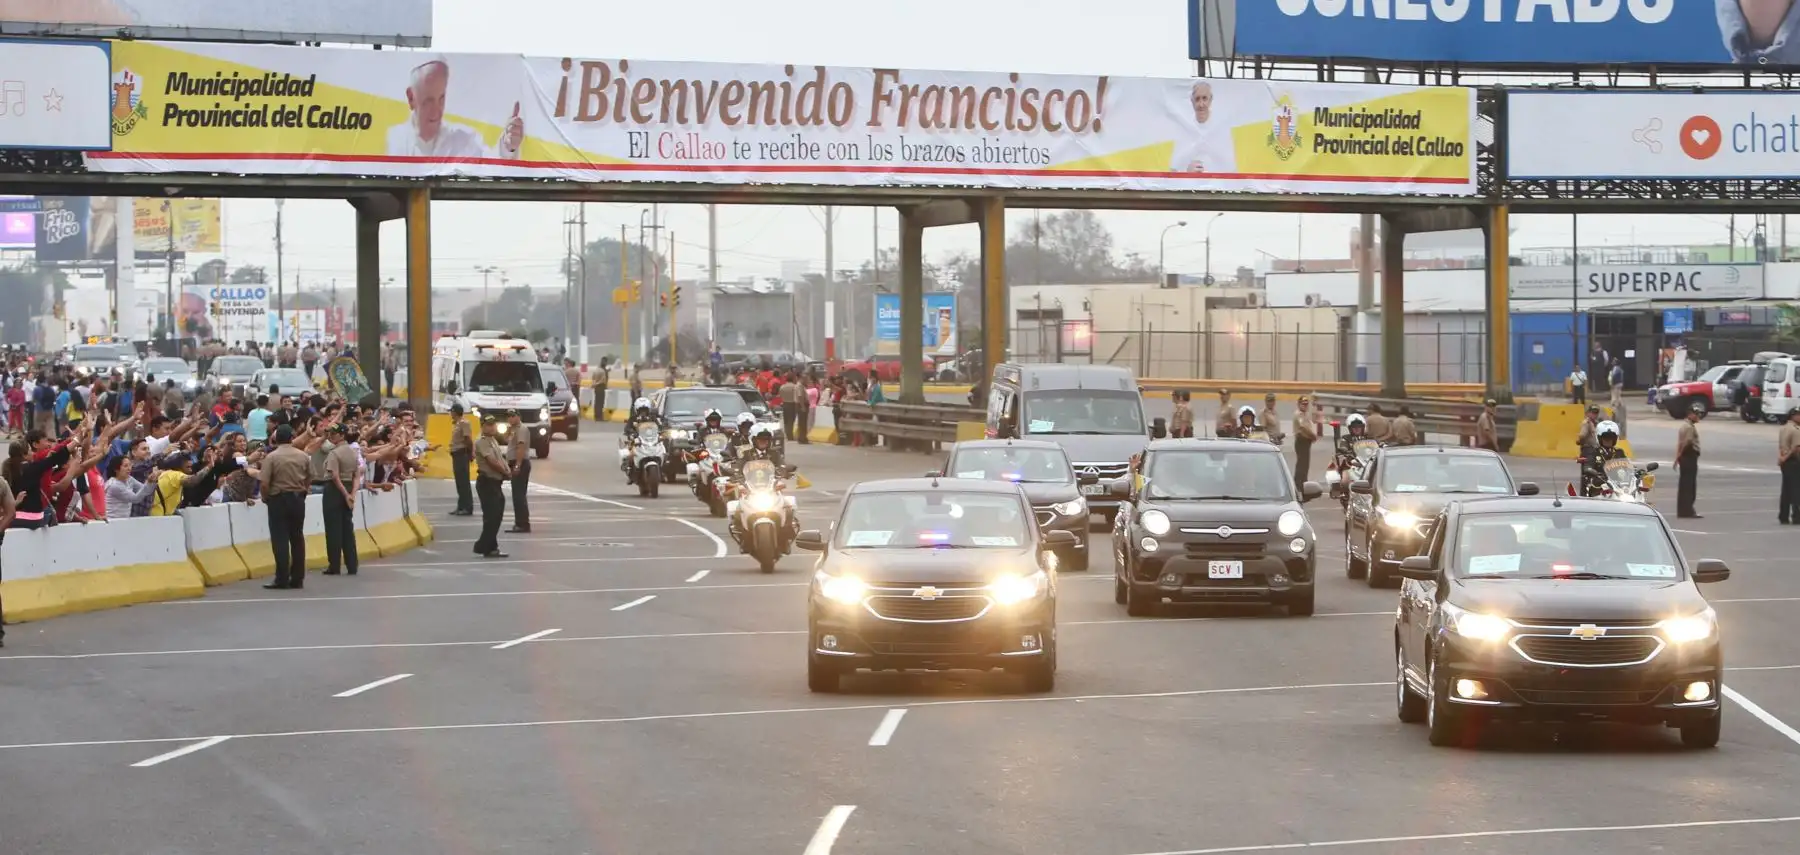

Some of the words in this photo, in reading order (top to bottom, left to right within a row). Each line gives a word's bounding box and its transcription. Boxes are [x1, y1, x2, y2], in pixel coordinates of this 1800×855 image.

[164, 71, 316, 101] Municipalidad
[554, 57, 854, 127] ¡Bienvenido
[866, 68, 1109, 133] Francisco!
[162, 102, 268, 128] Provincial
[271, 104, 303, 128] del
[306, 105, 372, 130] Callao
[1314, 107, 1422, 133] Municipalidad
[1313, 133, 1389, 156] Provincial
[1392, 135, 1414, 156] del
[1416, 136, 1464, 157] Callao
[1732, 111, 1799, 153] chat
[627, 131, 650, 159] El
[658, 132, 726, 160] Callao
[732, 136, 751, 160] te
[758, 134, 820, 160] recibe
[827, 142, 860, 161] con
[867, 135, 893, 161] los
[900, 135, 966, 164] brazos
[972, 137, 1050, 165] abiertos
[210, 287, 266, 300] CALLAO
[1589, 271, 1702, 293] SUPERPAC
[211, 308, 265, 316] ENVENIDA
[1211, 564, 1231, 575] SCV
